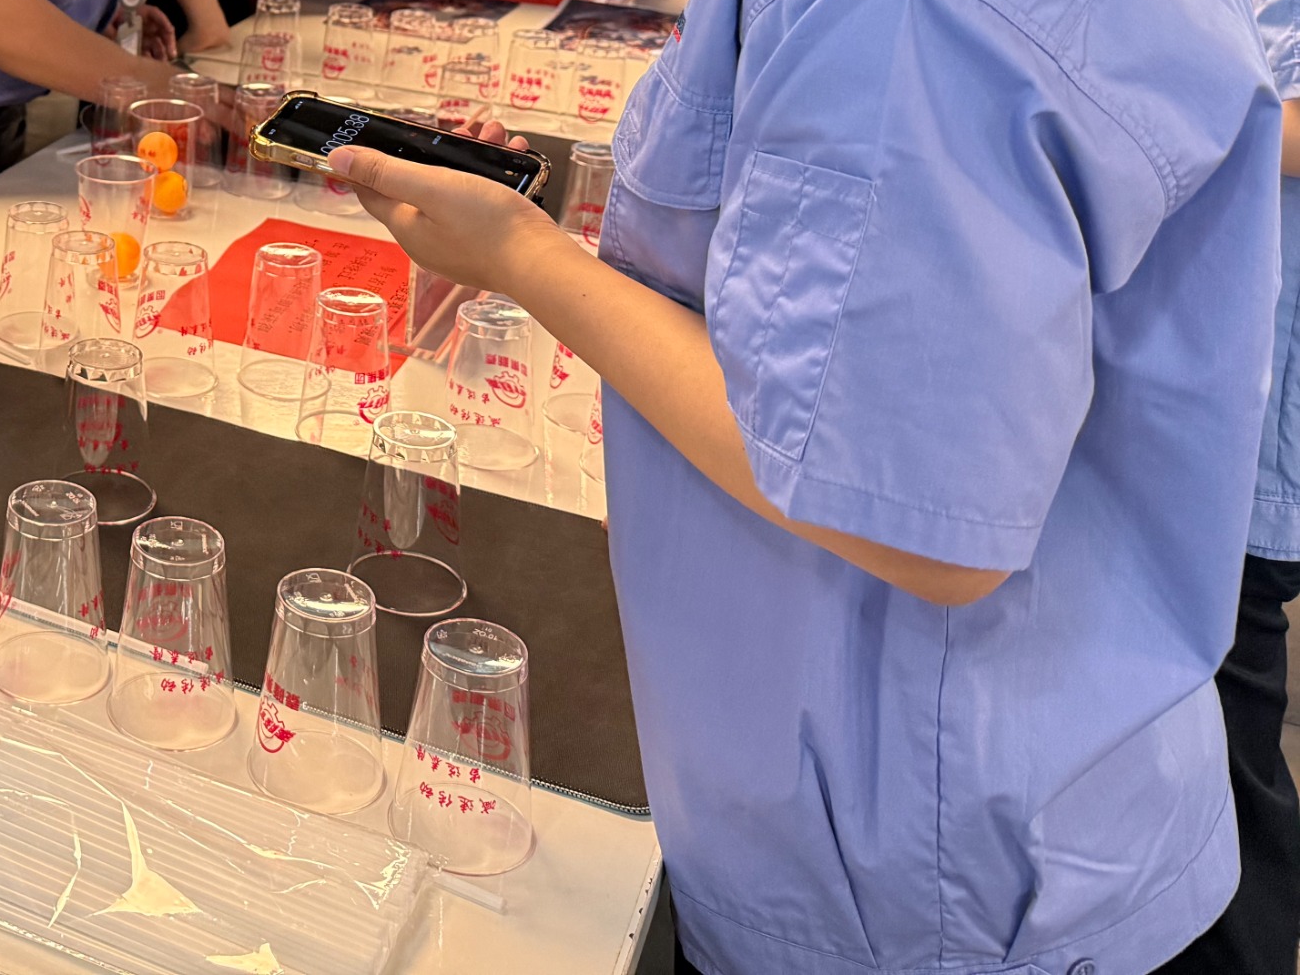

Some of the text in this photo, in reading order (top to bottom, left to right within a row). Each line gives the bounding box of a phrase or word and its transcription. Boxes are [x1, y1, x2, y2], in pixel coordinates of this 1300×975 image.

[414, 744, 481, 783] 当选泰隆
[419, 781, 497, 814] 减速传动
